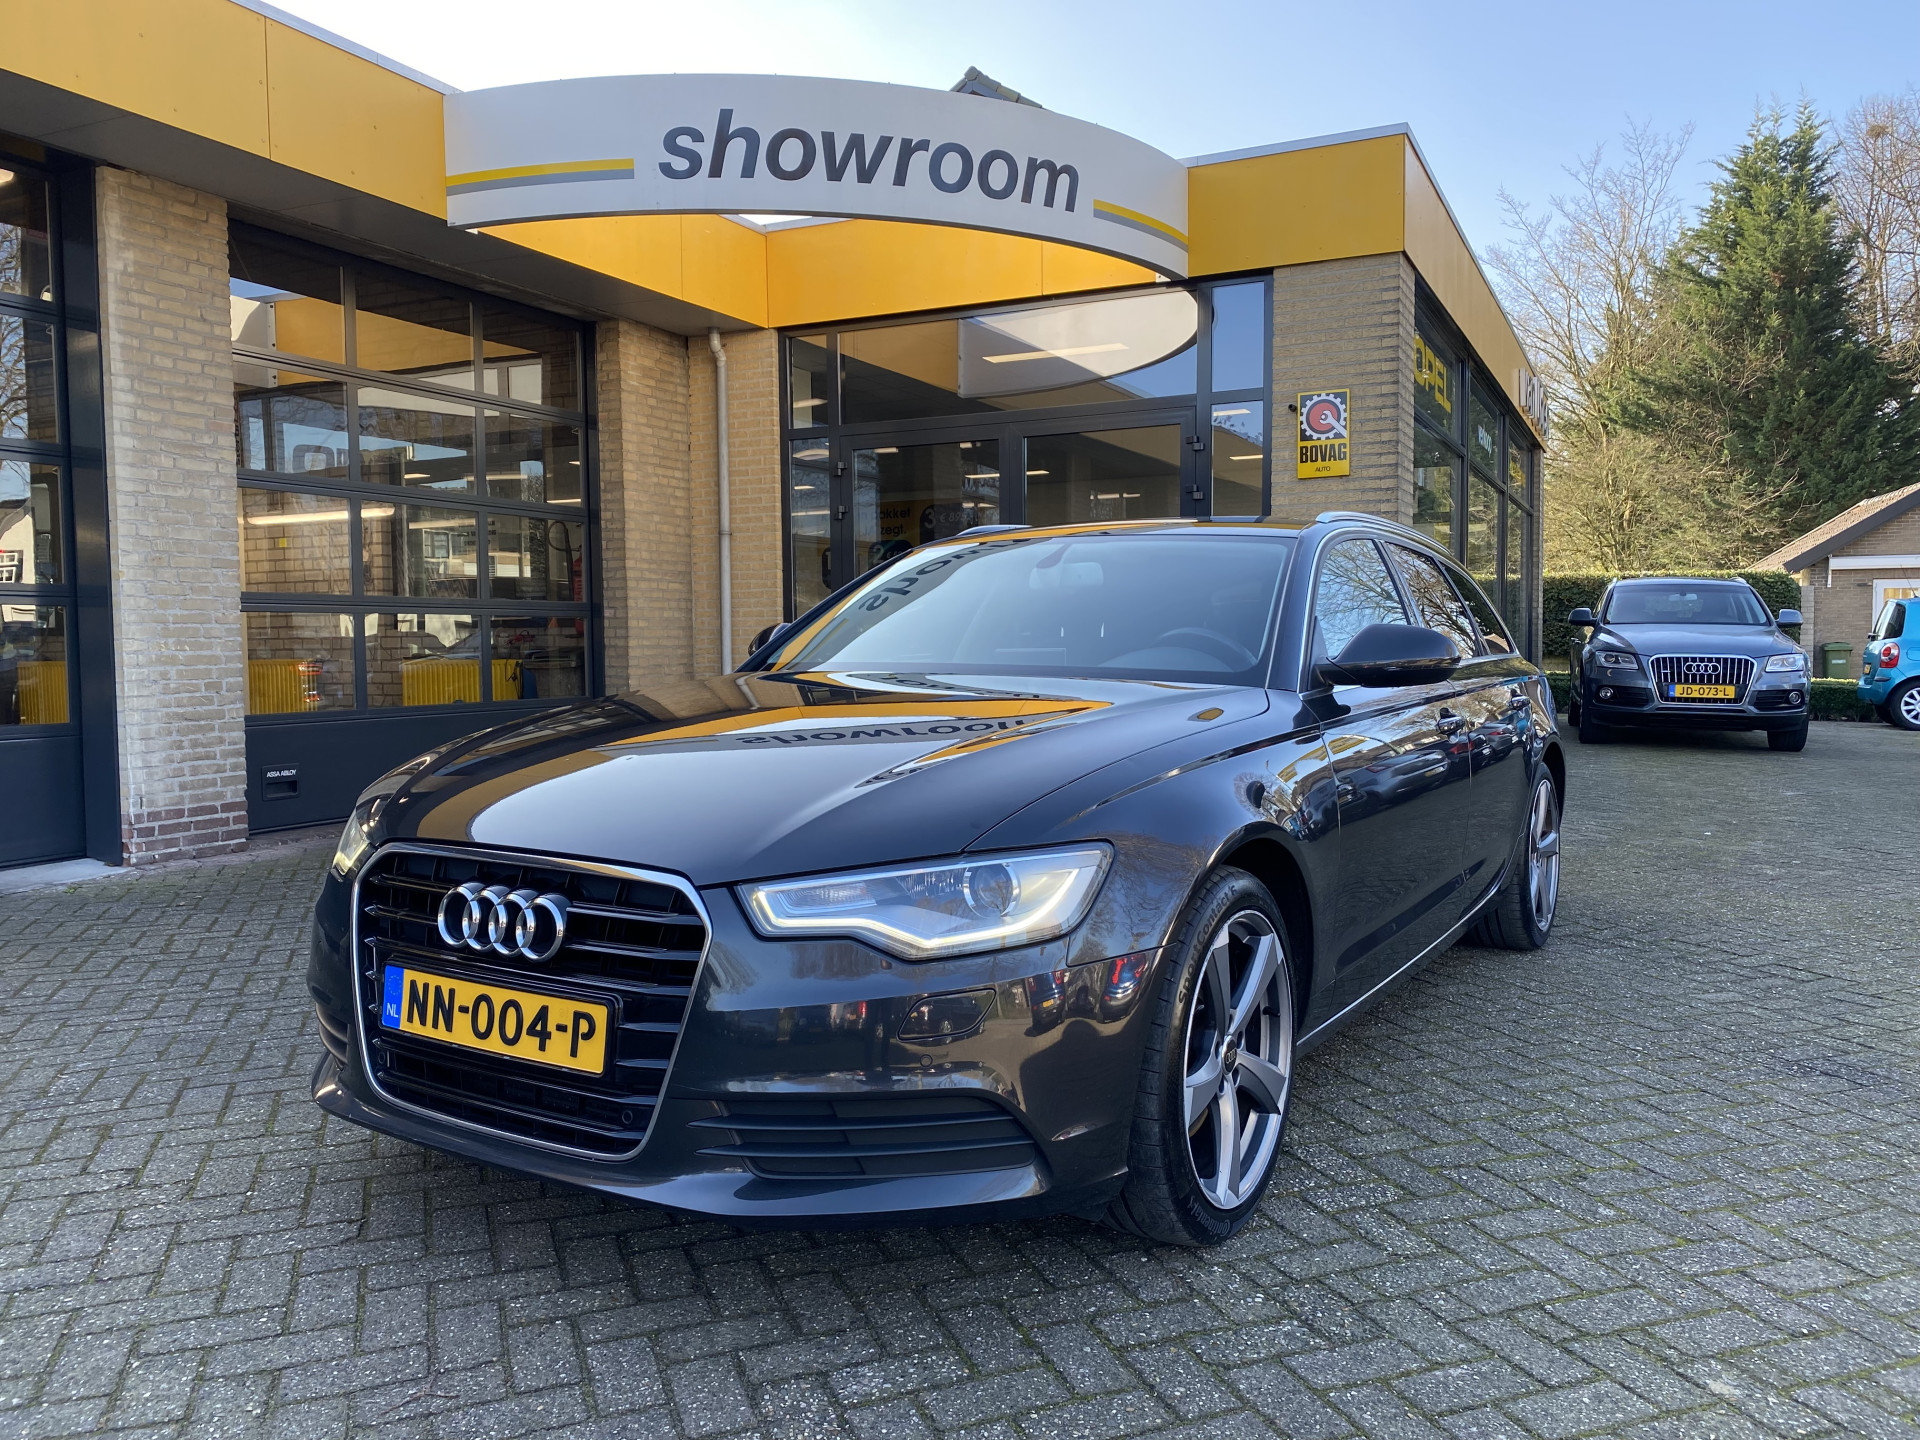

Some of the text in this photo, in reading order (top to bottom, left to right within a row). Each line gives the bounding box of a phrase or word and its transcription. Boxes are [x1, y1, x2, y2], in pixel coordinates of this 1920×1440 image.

[657, 108, 1080, 213] showroom
[1414, 333, 1451, 414] OPEL
[1299, 443, 1347, 464] BOVAG
[1679, 686, 1730, 697] JD-073-L
[386, 1002, 399, 1018] NL
[406, 979, 596, 1058] NN-004-P
[1190, 1202, 1232, 1237] Continental
